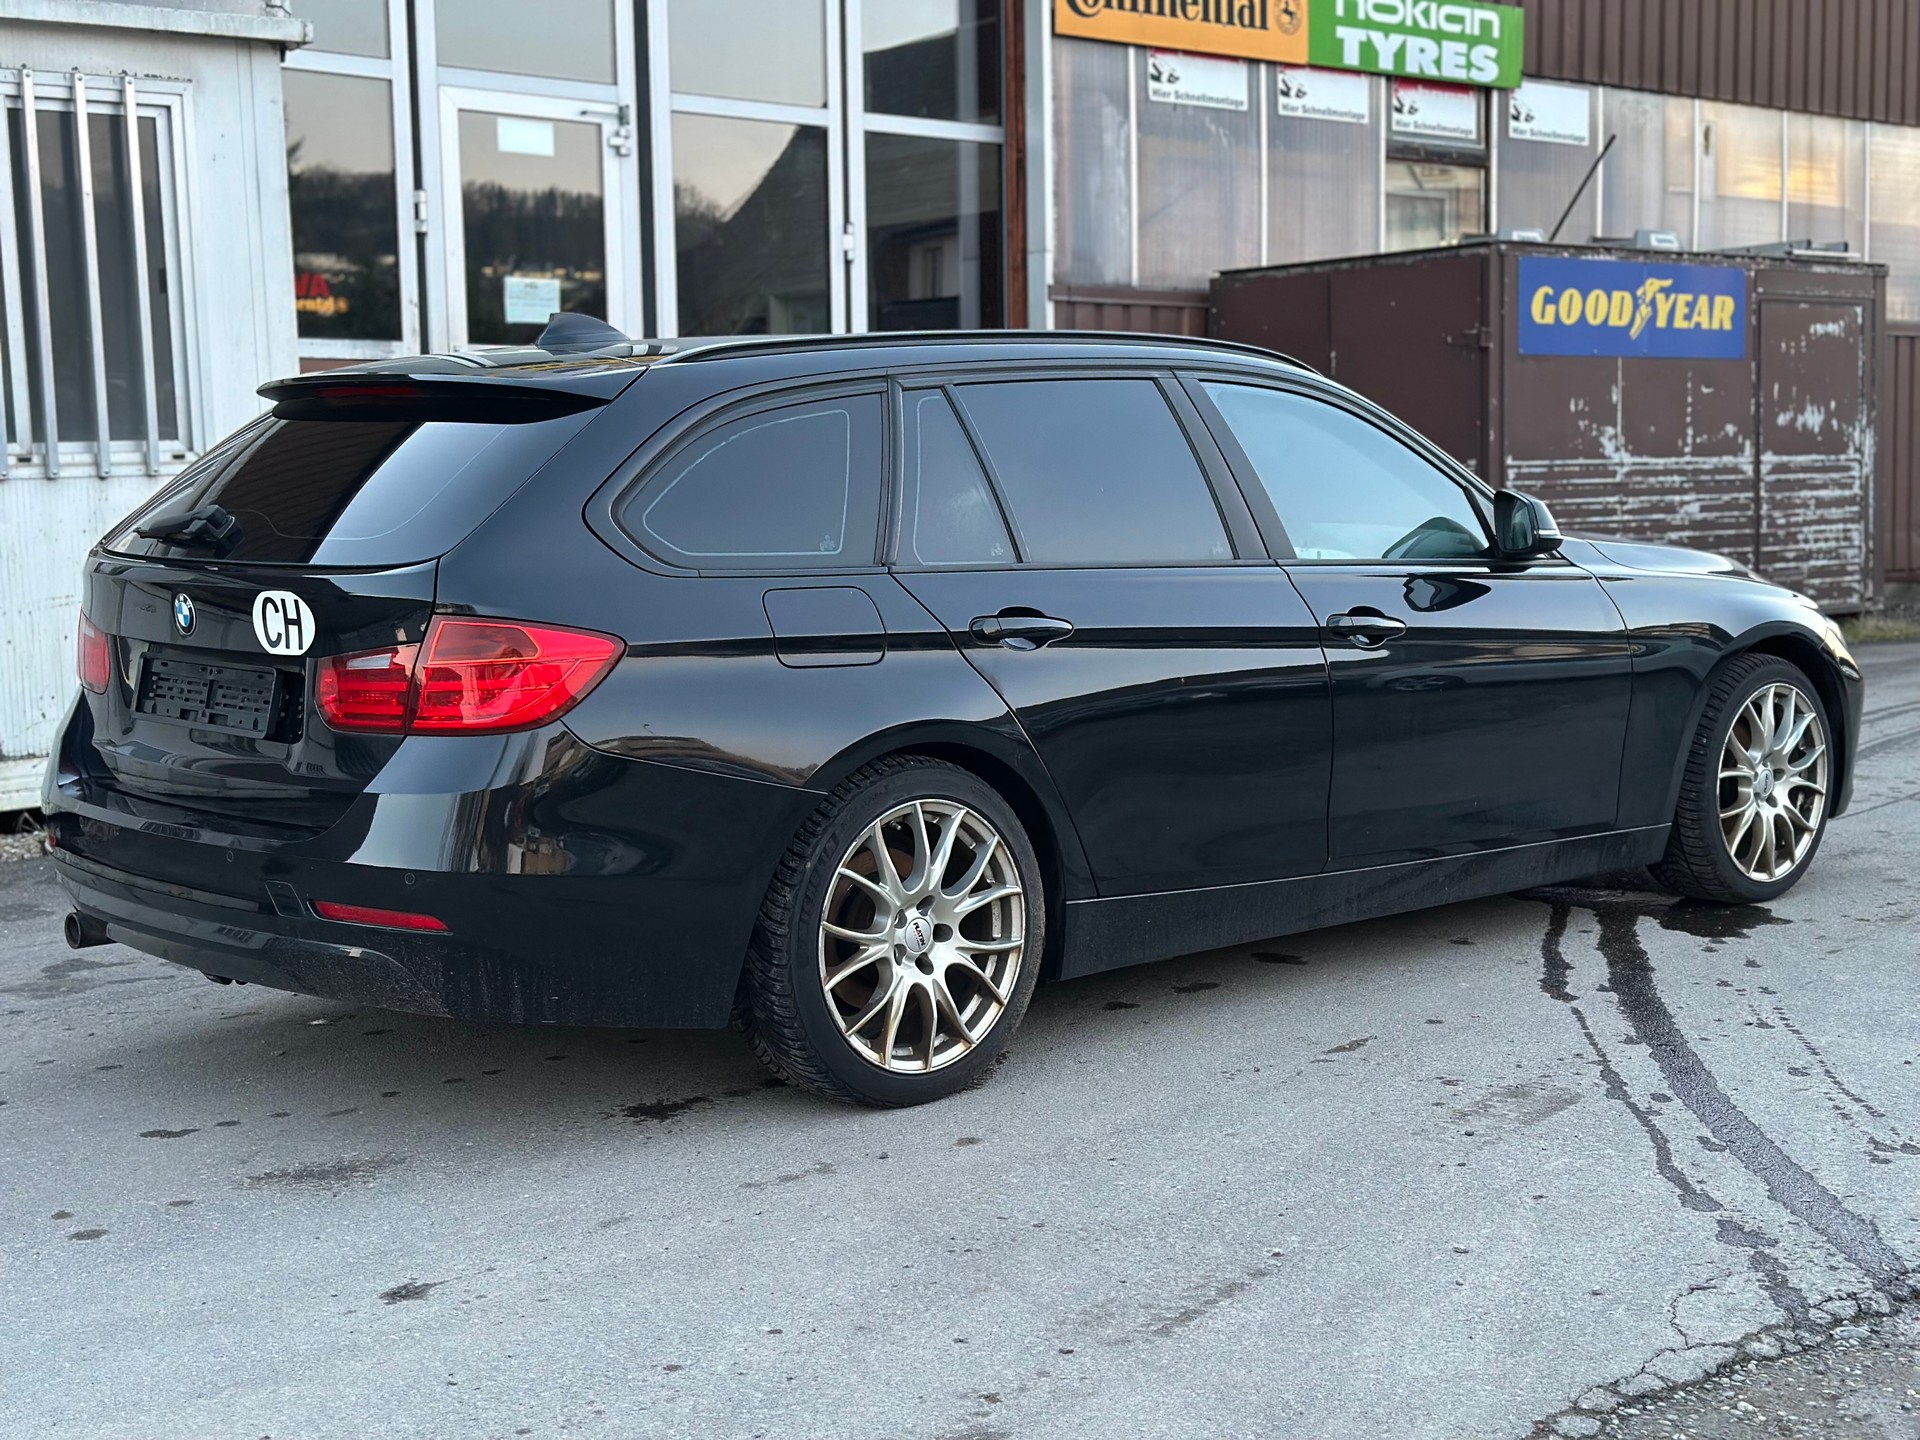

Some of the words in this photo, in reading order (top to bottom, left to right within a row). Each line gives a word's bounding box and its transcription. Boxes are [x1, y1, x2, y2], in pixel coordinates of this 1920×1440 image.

[1335, 25, 1500, 83] TYRES
[1151, 88, 1172, 98] Hier
[1174, 90, 1245, 108] Schnellmontage
[261, 596, 304, 650] CH
